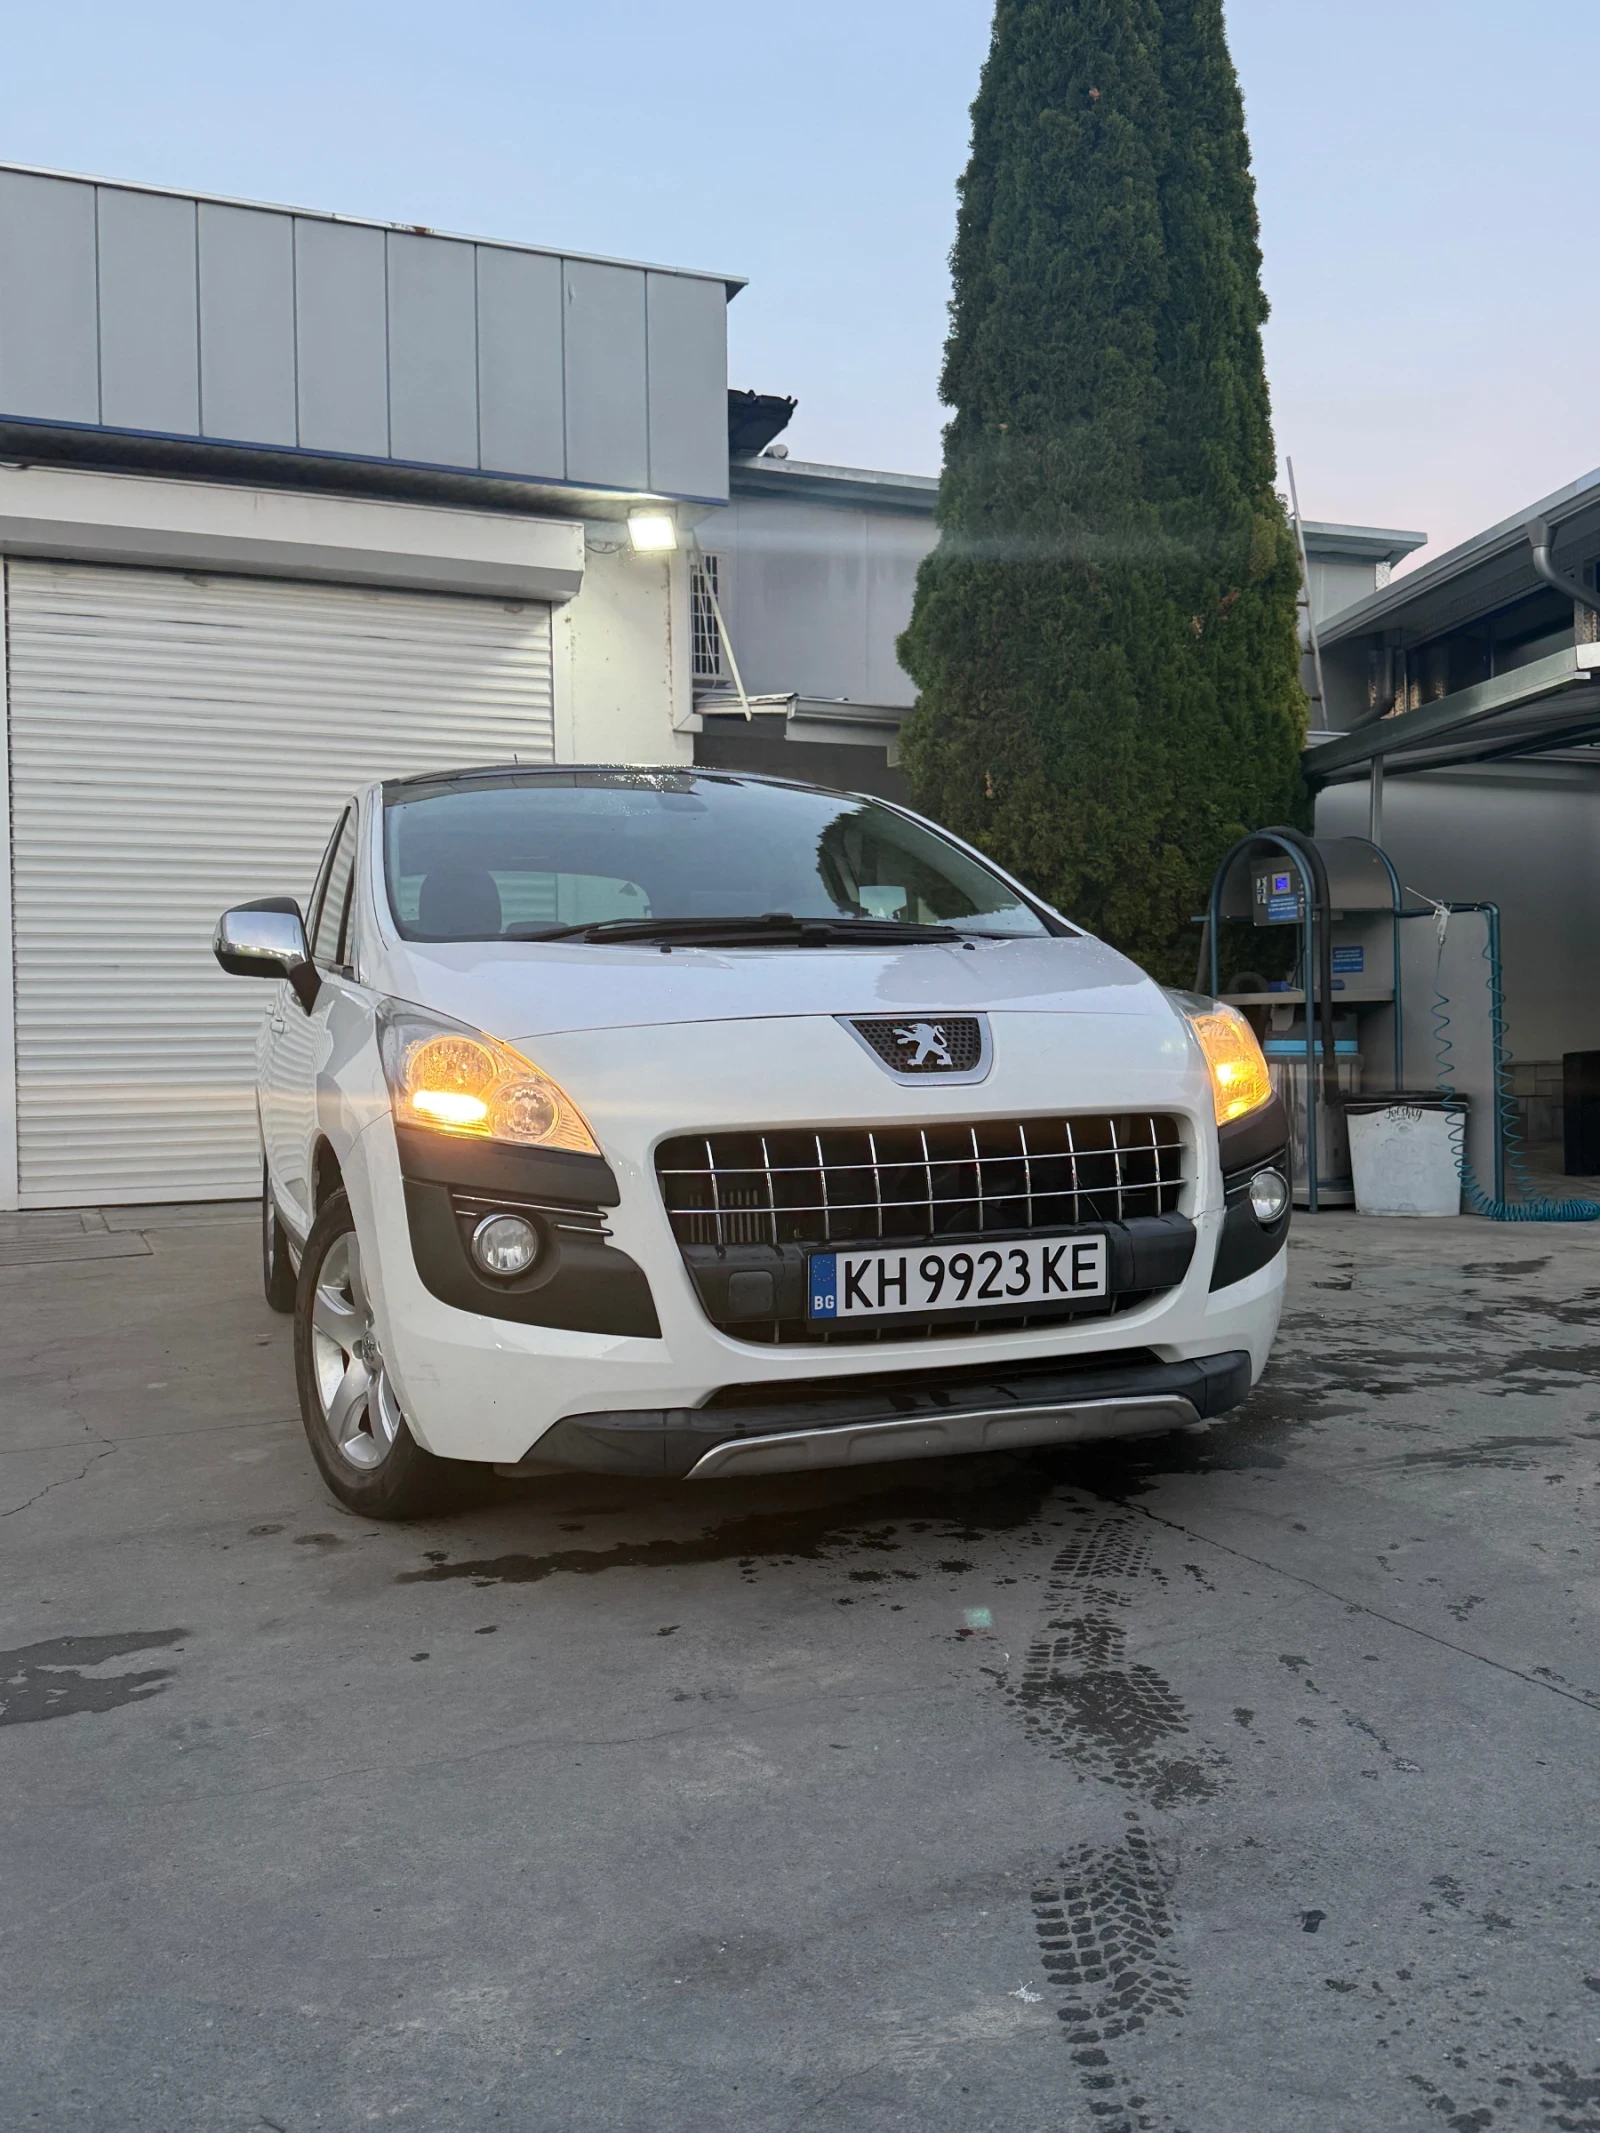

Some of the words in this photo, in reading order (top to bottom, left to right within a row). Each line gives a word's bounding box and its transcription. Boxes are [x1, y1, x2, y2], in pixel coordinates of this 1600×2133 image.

[844, 1257, 907, 1309] KH
[919, 1249, 1031, 1303] 9923
[1042, 1243, 1098, 1293] KE
[814, 1295, 835, 1310] BG
